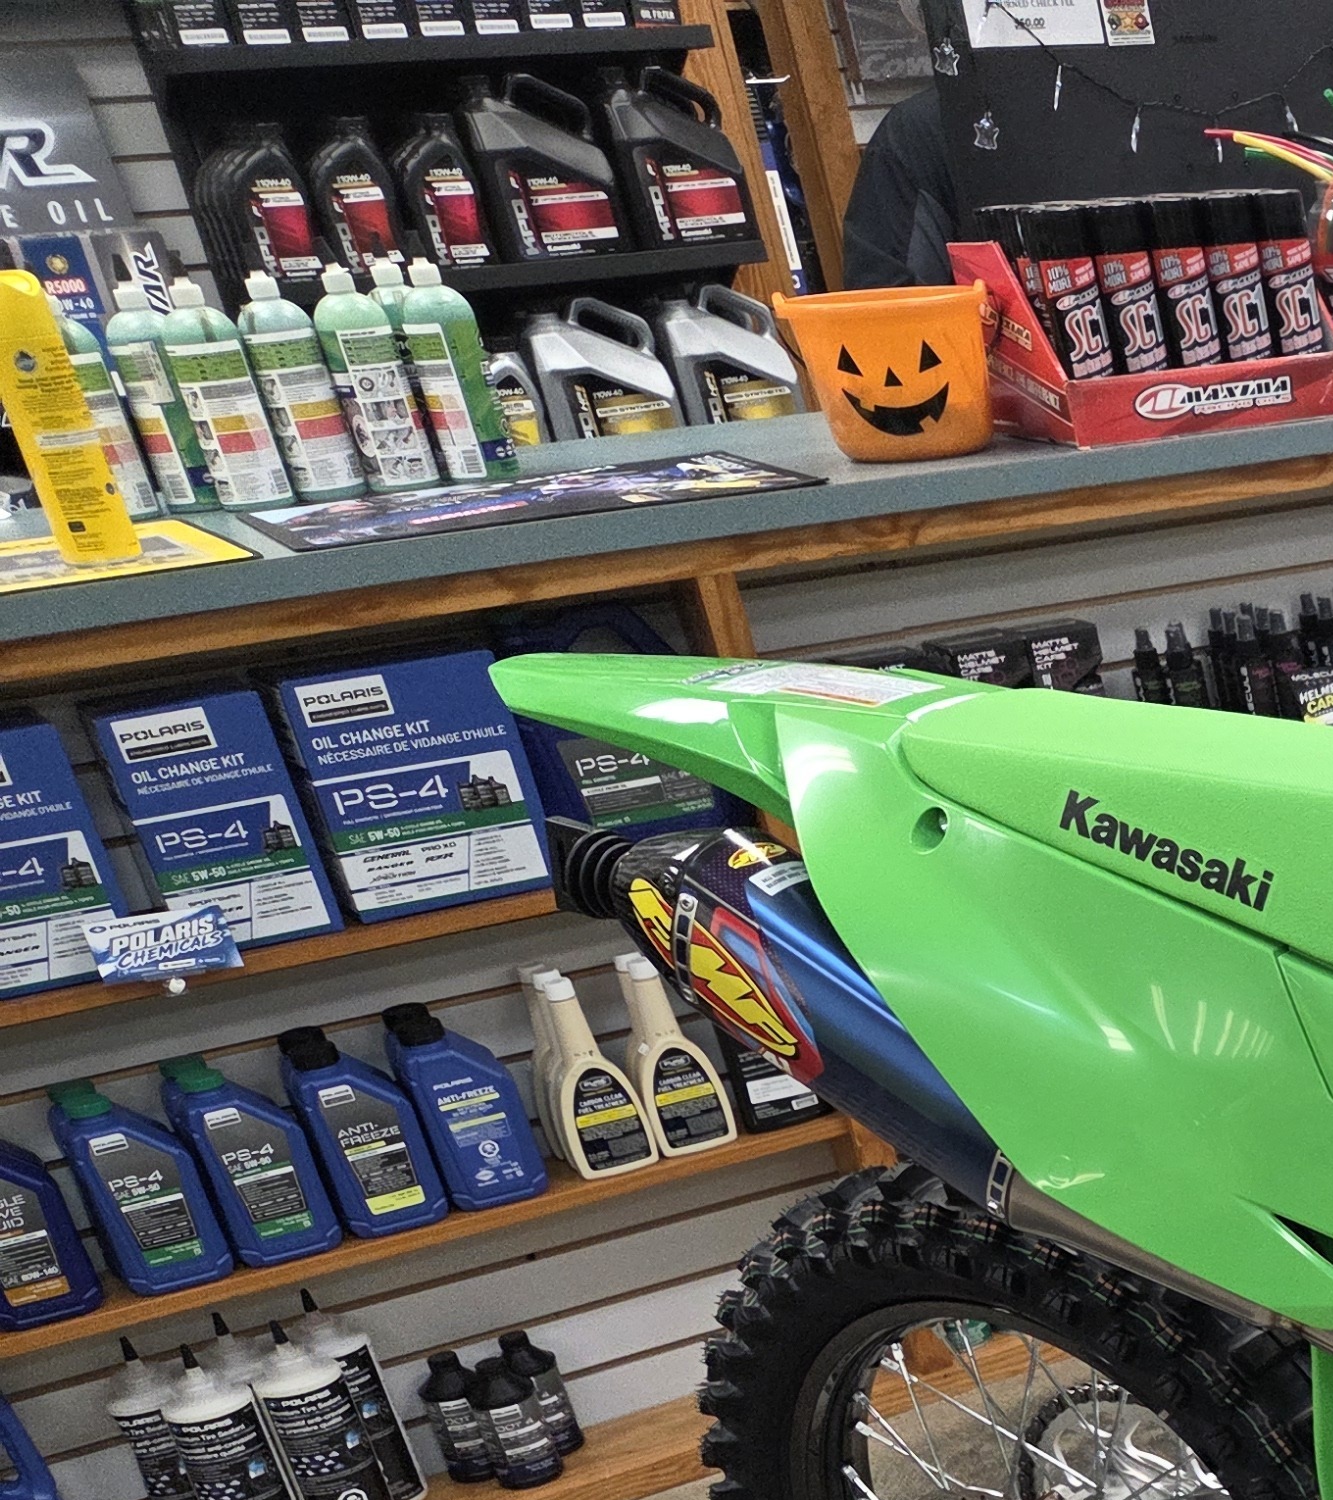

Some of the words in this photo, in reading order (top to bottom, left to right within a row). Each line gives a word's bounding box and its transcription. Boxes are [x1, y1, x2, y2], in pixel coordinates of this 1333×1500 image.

[47, 198, 114, 226] OIL
[302, 685, 384, 708] POLARIS
[119, 720, 205, 744] POLARIS
[311, 735, 339, 751] OIL
[340, 723, 404, 746] CHANGE
[405, 719, 431, 735] KIT
[318, 742, 391, 766] NÉCESSAIRE
[395, 741, 410, 753] DE
[410, 731, 462, 751] VIDANGE
[463, 725, 507, 742] D'HUILE
[131, 770, 157, 785] OIL
[157, 760, 216, 780] CHANGE
[217, 752, 245, 767] KIT
[575, 752, 651, 777] PS-4
[17, 789, 42, 807] KIT
[332, 774, 449, 816] PS-4
[155, 819, 250, 854] PS-4
[1059, 789, 1275, 913] Kawasaki
[112, 916, 215, 957] POLARIS
[116, 929, 224, 970] CHEMICALS
[437, 1085, 497, 1106] ANTI-FREEZE
[337, 1122, 379, 1139] ANTI-
[340, 1125, 401, 1148] FREEZE
[221, 1143, 274, 1166] PS-4
[108, 1169, 164, 1193] PS-4
[281, 1389, 332, 1408] POLARIS
[181, 1418, 233, 1434] POLARIS
